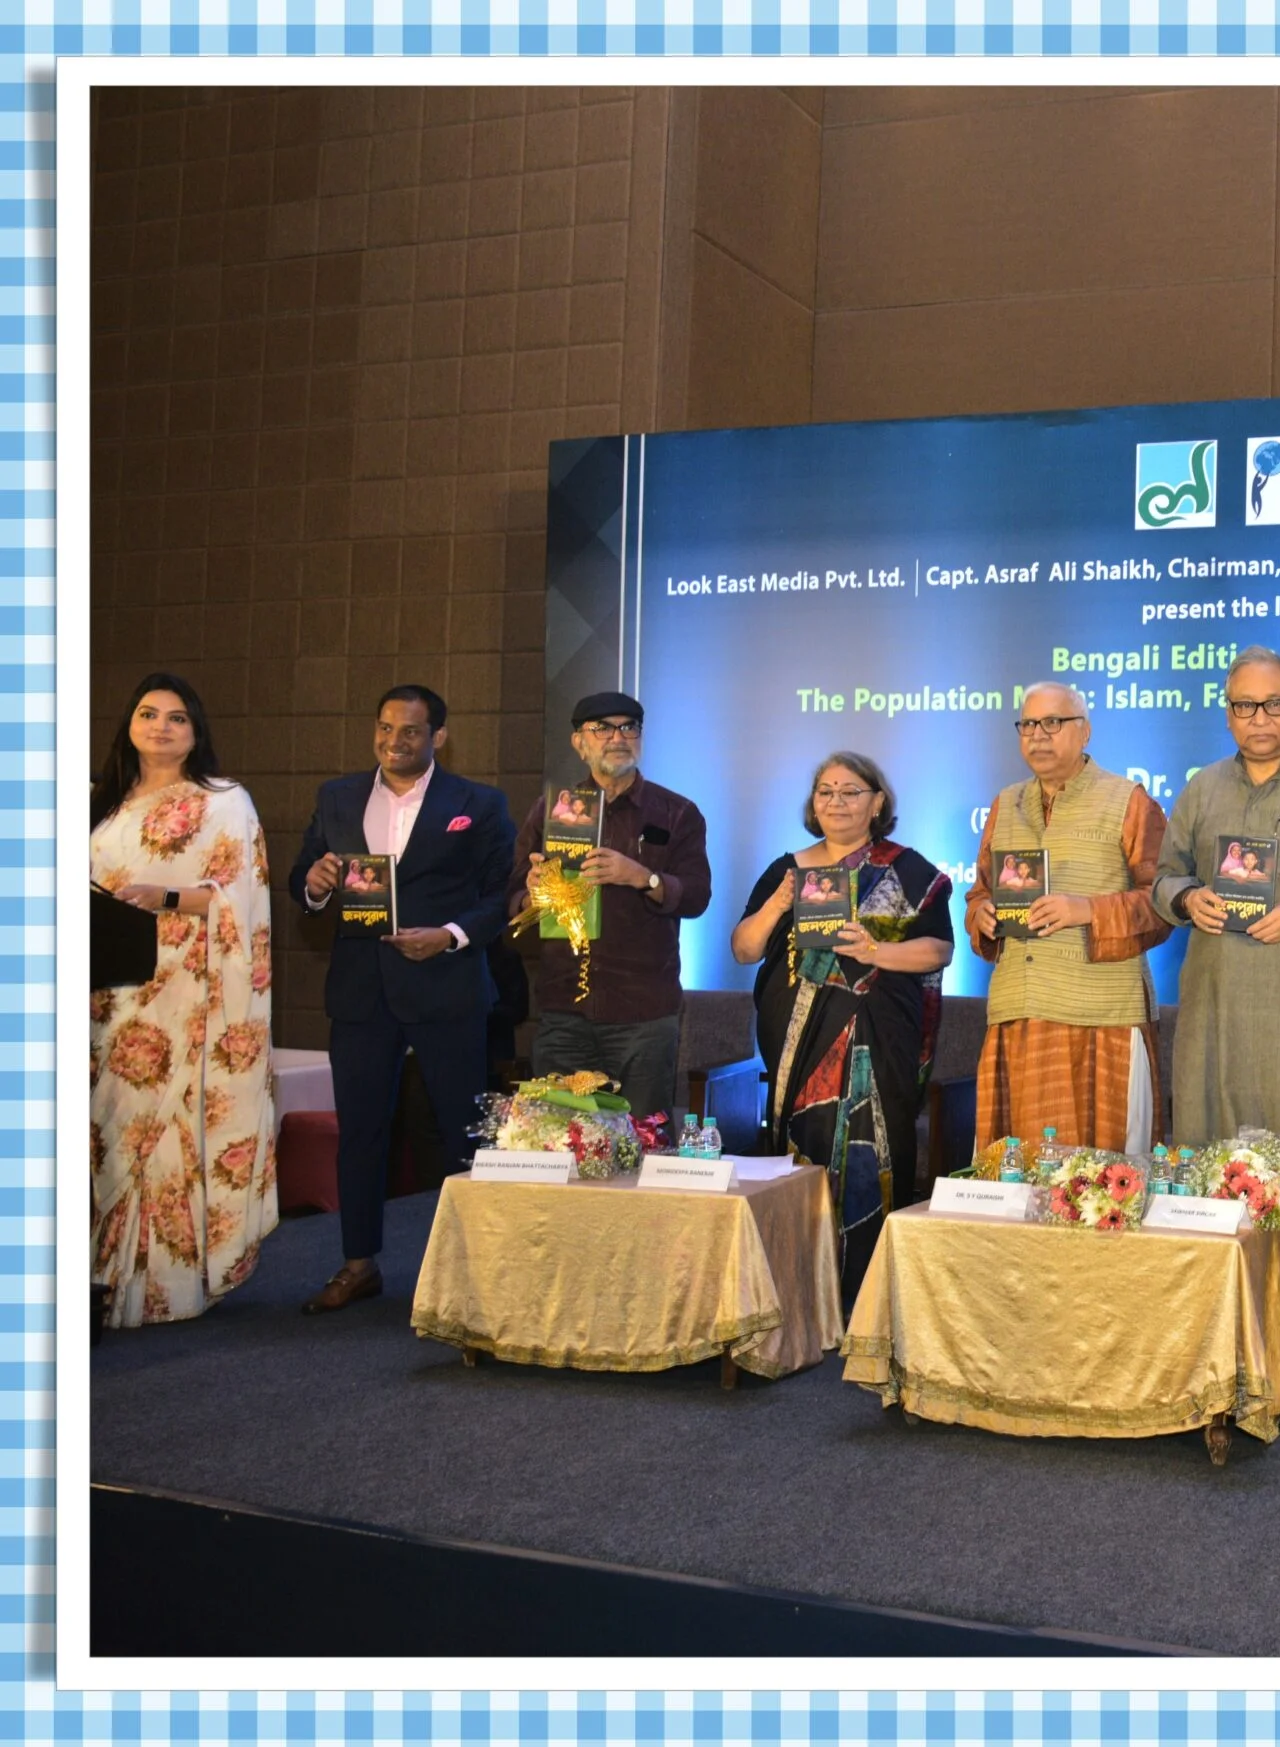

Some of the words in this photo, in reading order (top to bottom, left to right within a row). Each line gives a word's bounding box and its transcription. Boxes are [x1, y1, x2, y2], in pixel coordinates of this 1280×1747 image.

[667, 575, 712, 595] Look
[717, 574, 756, 594] East
[761, 571, 819, 592] Media
[826, 570, 862, 590] Pvt.
[868, 567, 905, 588] Ltd.
[926, 566, 979, 590] Capt.
[985, 562, 1039, 584] Asraf
[1049, 561, 1077, 582] Ali
[1083, 559, 1162, 582] Shaikh,
[1168, 557, 1280, 580] Chairman,
[1142, 600, 1226, 626] present
[1231, 597, 1268, 619] the
[1052, 644, 1160, 679] Bengali
[797, 688, 845, 713] The
[855, 685, 1002, 718] Population
[1106, 680, 1190, 713] Islam,
